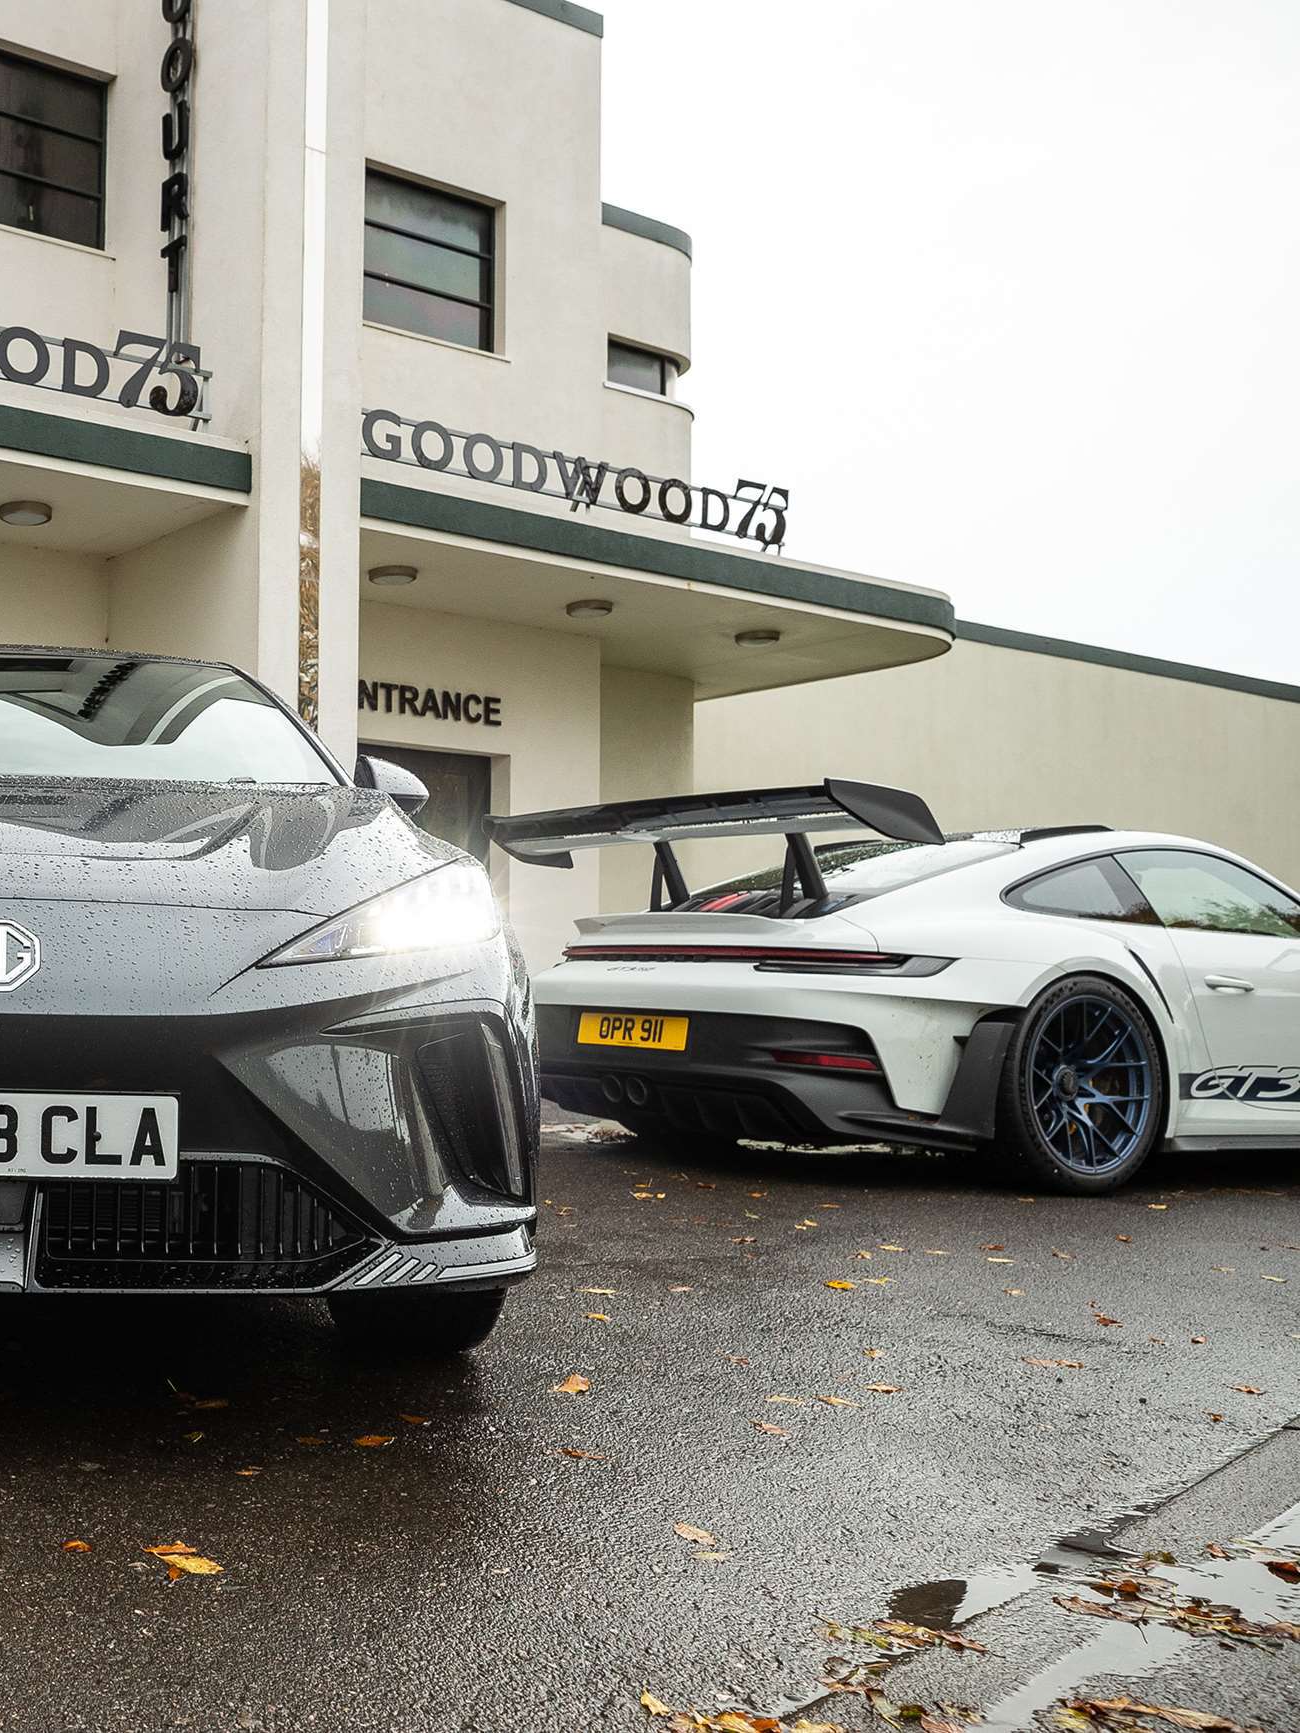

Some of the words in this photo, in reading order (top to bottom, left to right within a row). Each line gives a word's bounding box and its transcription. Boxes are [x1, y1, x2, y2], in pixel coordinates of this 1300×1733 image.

[357, 679, 502, 727] NTRANCE
[599, 1016, 636, 1041] OPR
[640, 1019, 665, 1043] 911
[1190, 1064, 1300, 1099] GT3
[40, 1104, 166, 1167] CLA
